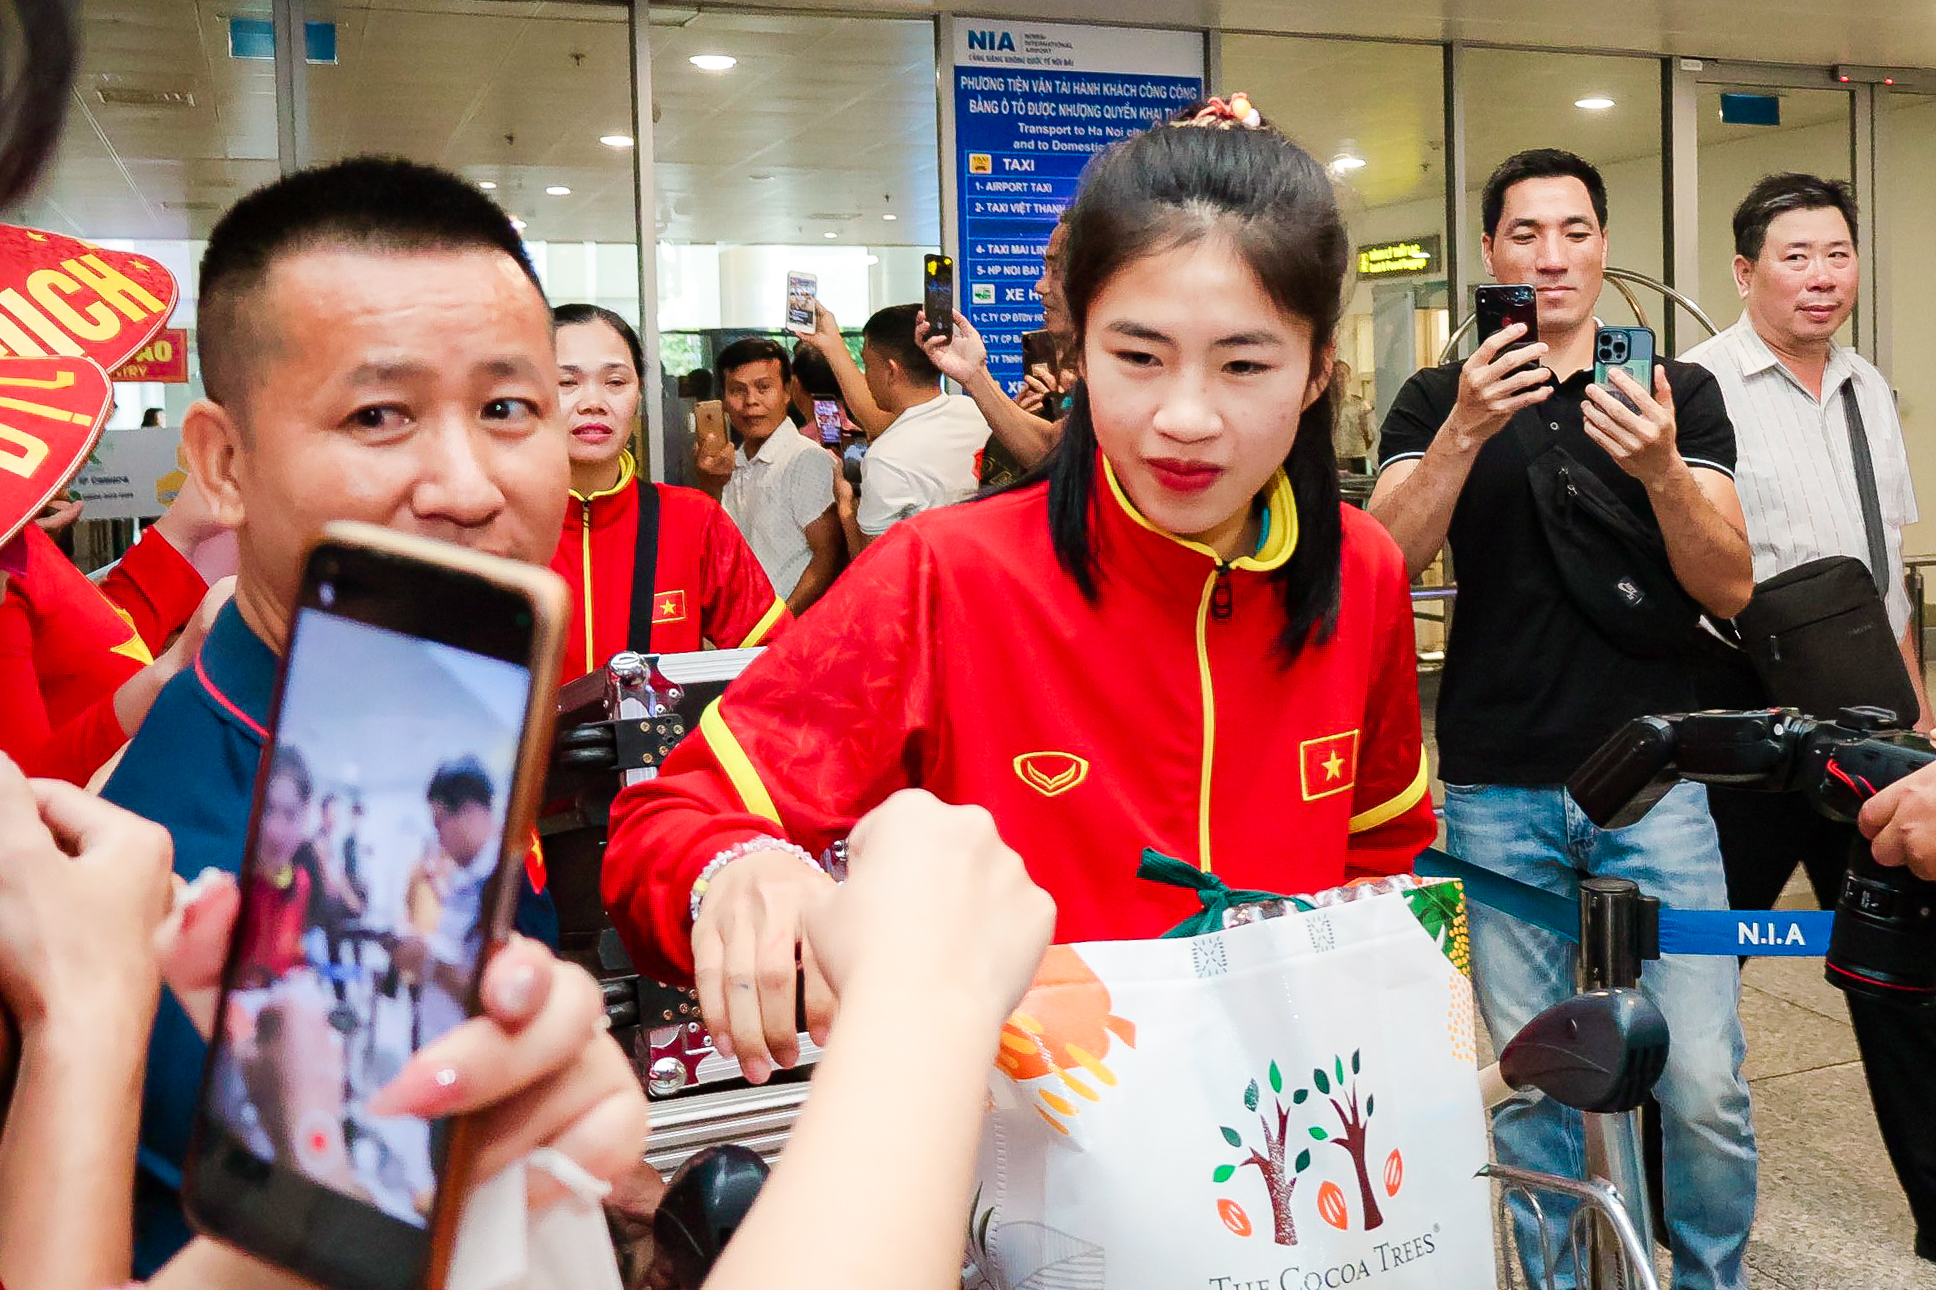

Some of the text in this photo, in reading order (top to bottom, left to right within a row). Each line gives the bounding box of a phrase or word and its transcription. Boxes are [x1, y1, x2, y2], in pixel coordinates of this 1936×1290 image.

[968, 29, 1016, 52] NIA
[1017, 122, 1072, 137] Transport
[1074, 125, 1085, 136] to
[1088, 126, 1103, 137] Ha
[1105, 126, 1124, 138] Noi
[1013, 139, 1035, 150] and
[1037, 140, 1049, 150] to
[1002, 158, 1035, 171] TAXI
[986, 182, 1029, 192] AIRPORT
[1030, 183, 1053, 193] TAXI
[986, 202, 1009, 213] TAXI
[987, 244, 1010, 255] TAXI
[1010, 245, 1029, 255] MAI
[1005, 288, 1026, 301] XE
[1737, 921, 1807, 946] N.I.A
[1279, 1259, 1371, 1290] COCOA
